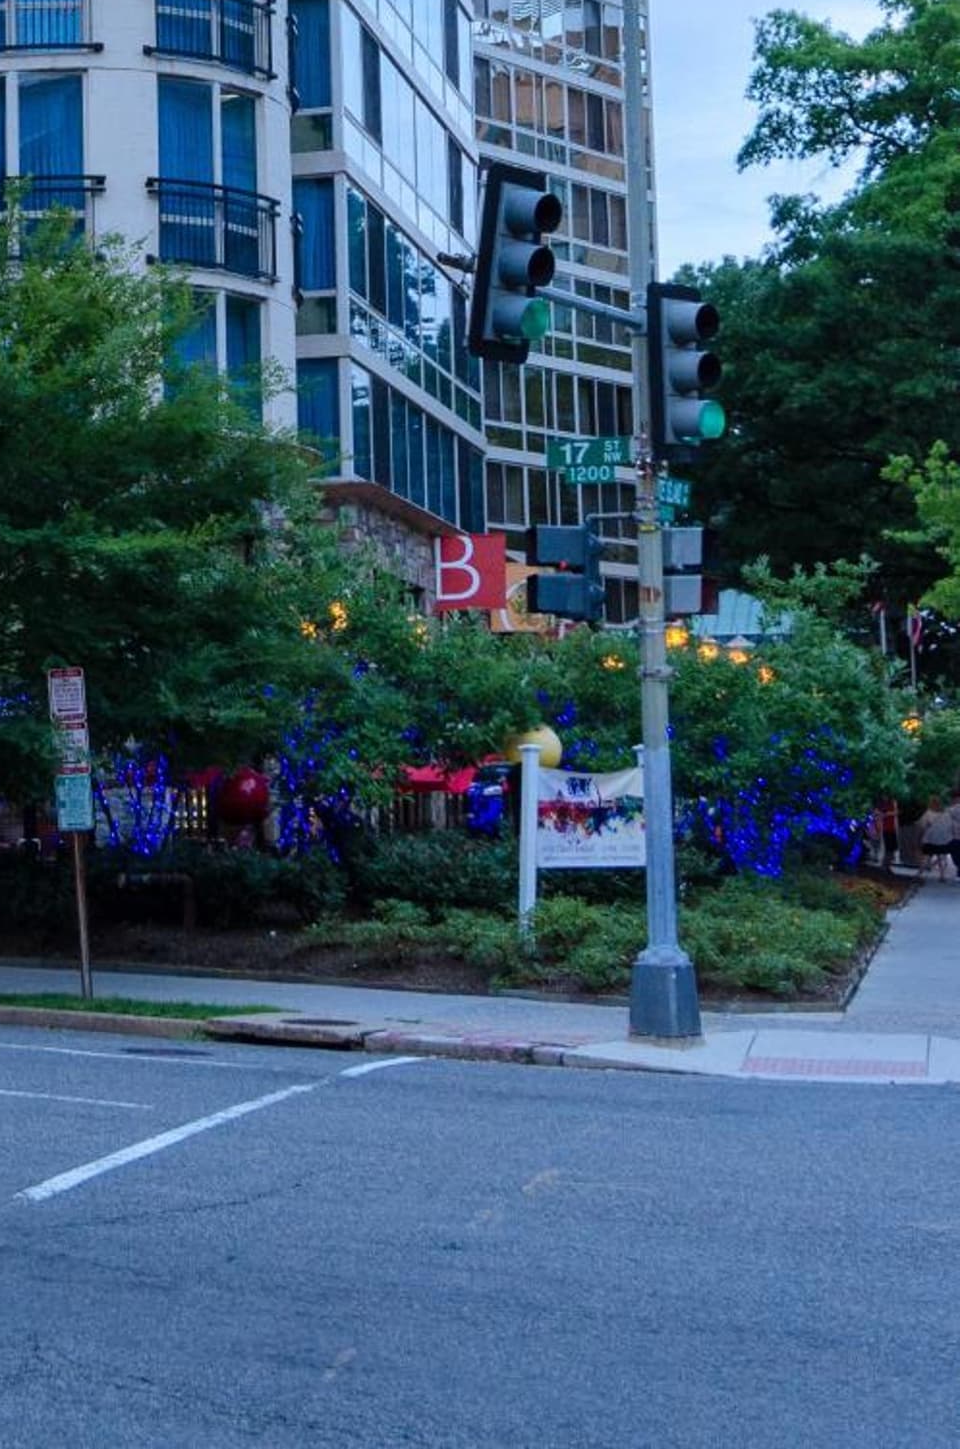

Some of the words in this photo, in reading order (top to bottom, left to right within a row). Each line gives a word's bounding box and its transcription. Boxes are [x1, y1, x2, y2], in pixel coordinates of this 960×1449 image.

[560, 442, 589, 464] 17
[604, 440, 620, 451] ST
[603, 451, 622, 463] NW
[570, 466, 610, 482] 1200
[434, 535, 480, 601] B
